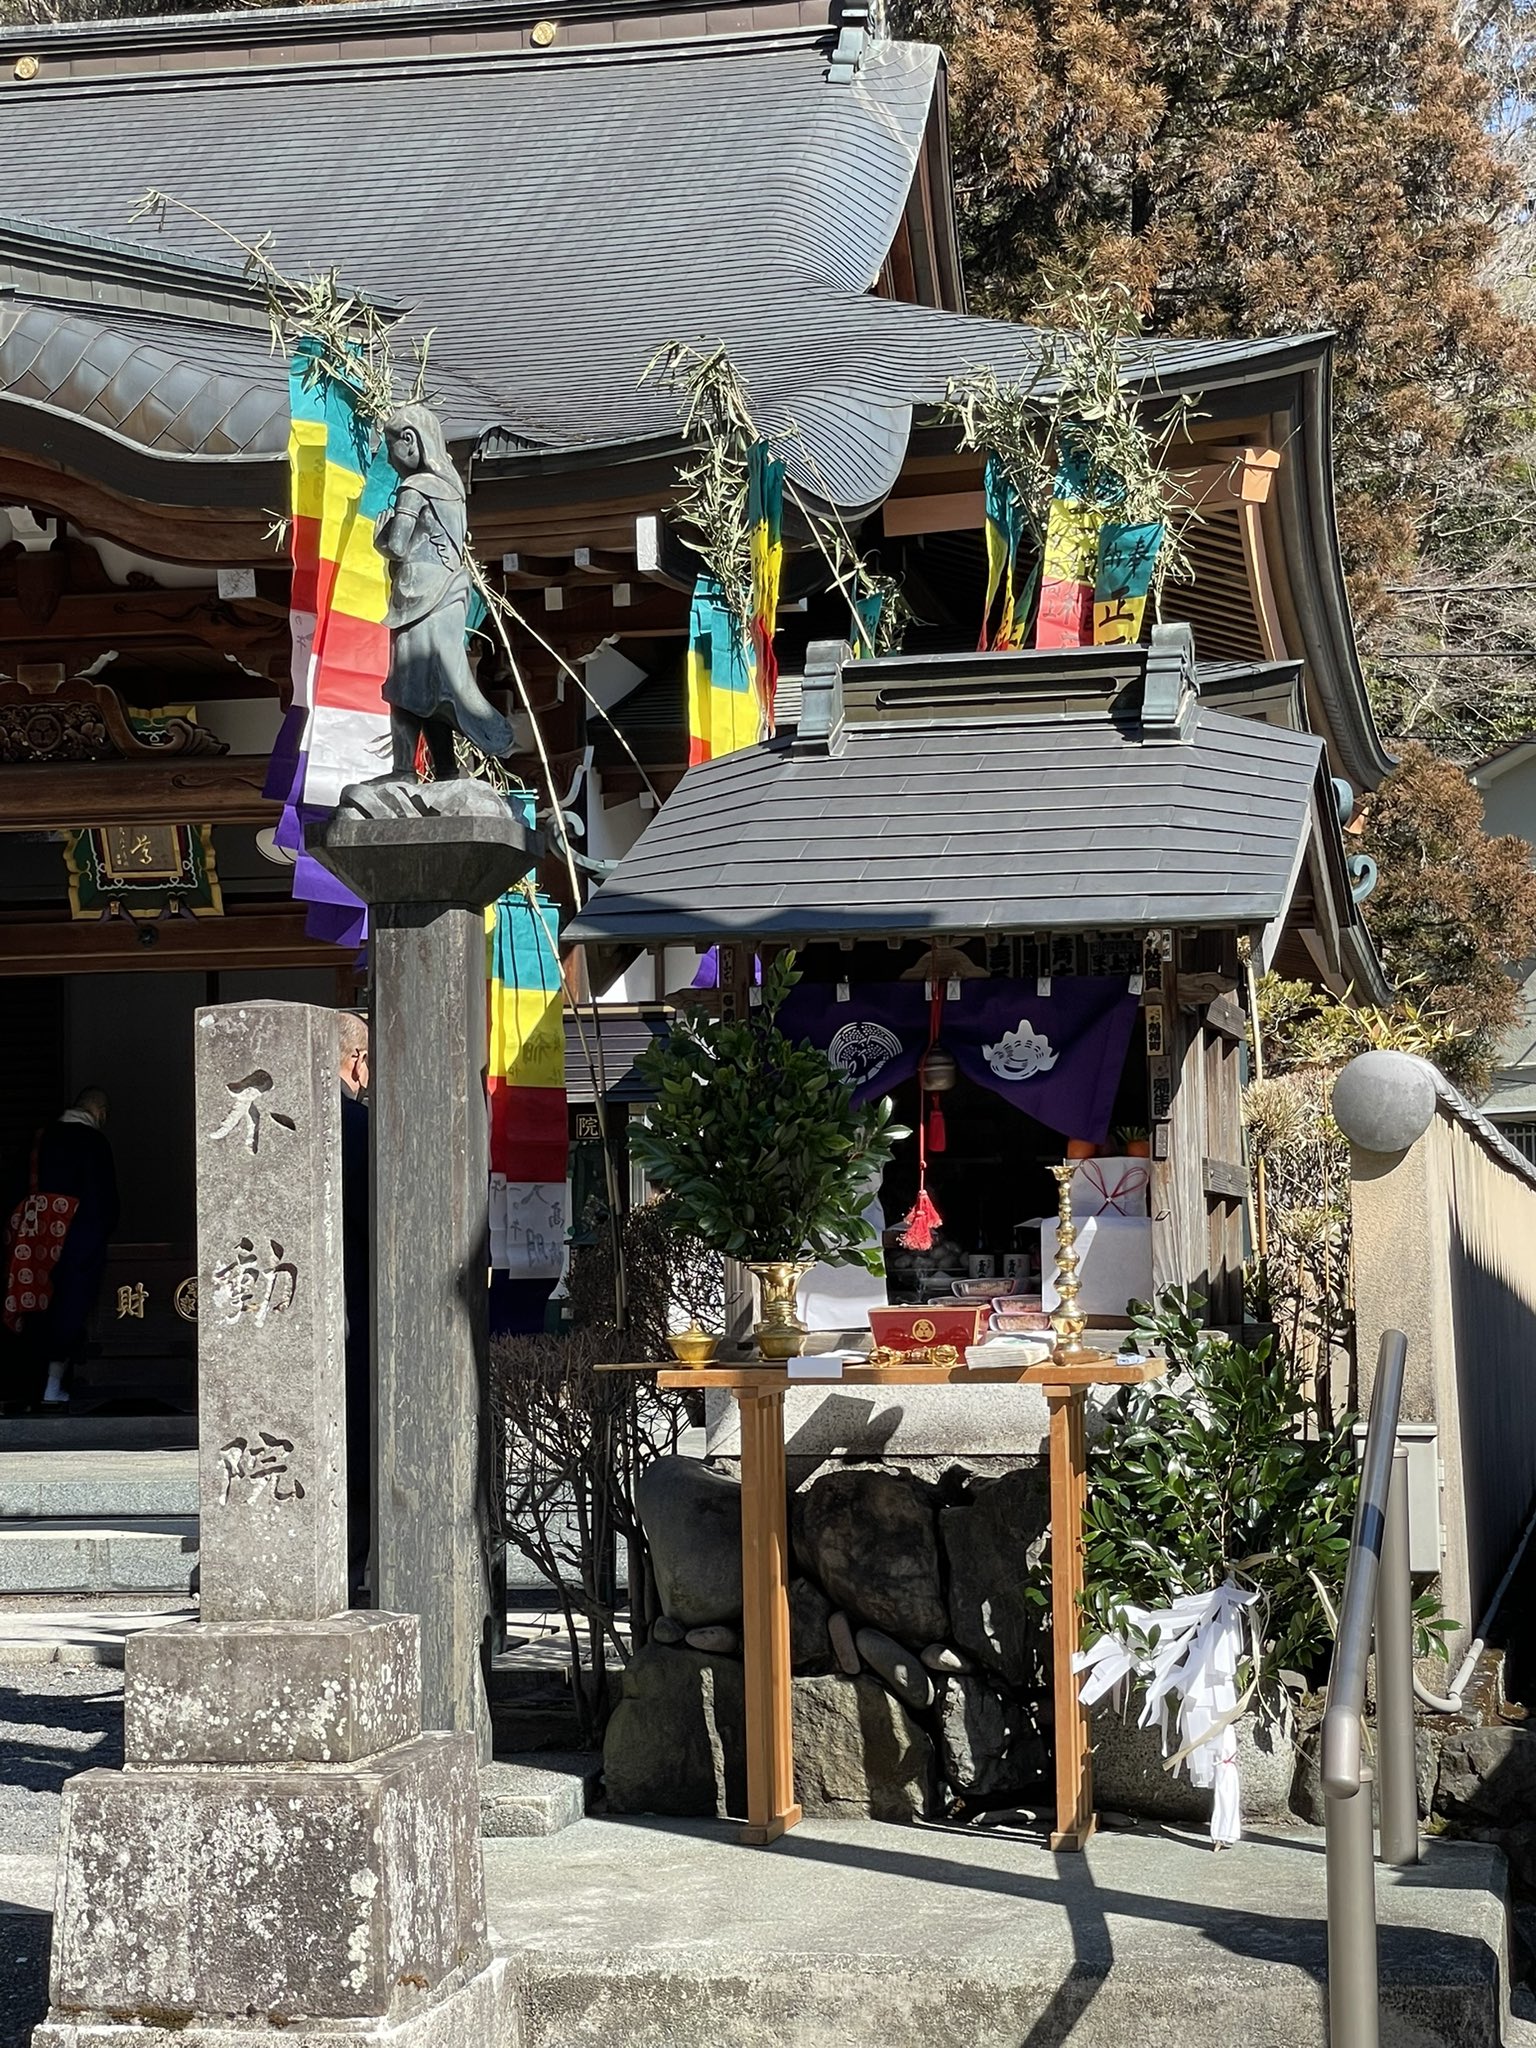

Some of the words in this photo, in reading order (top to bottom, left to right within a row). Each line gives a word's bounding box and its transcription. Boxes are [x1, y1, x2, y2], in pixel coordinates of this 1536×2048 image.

[578, 1116, 599, 1137] 院
[116, 1281, 150, 1320] 財
[209, 1069, 306, 1508] 不動院
